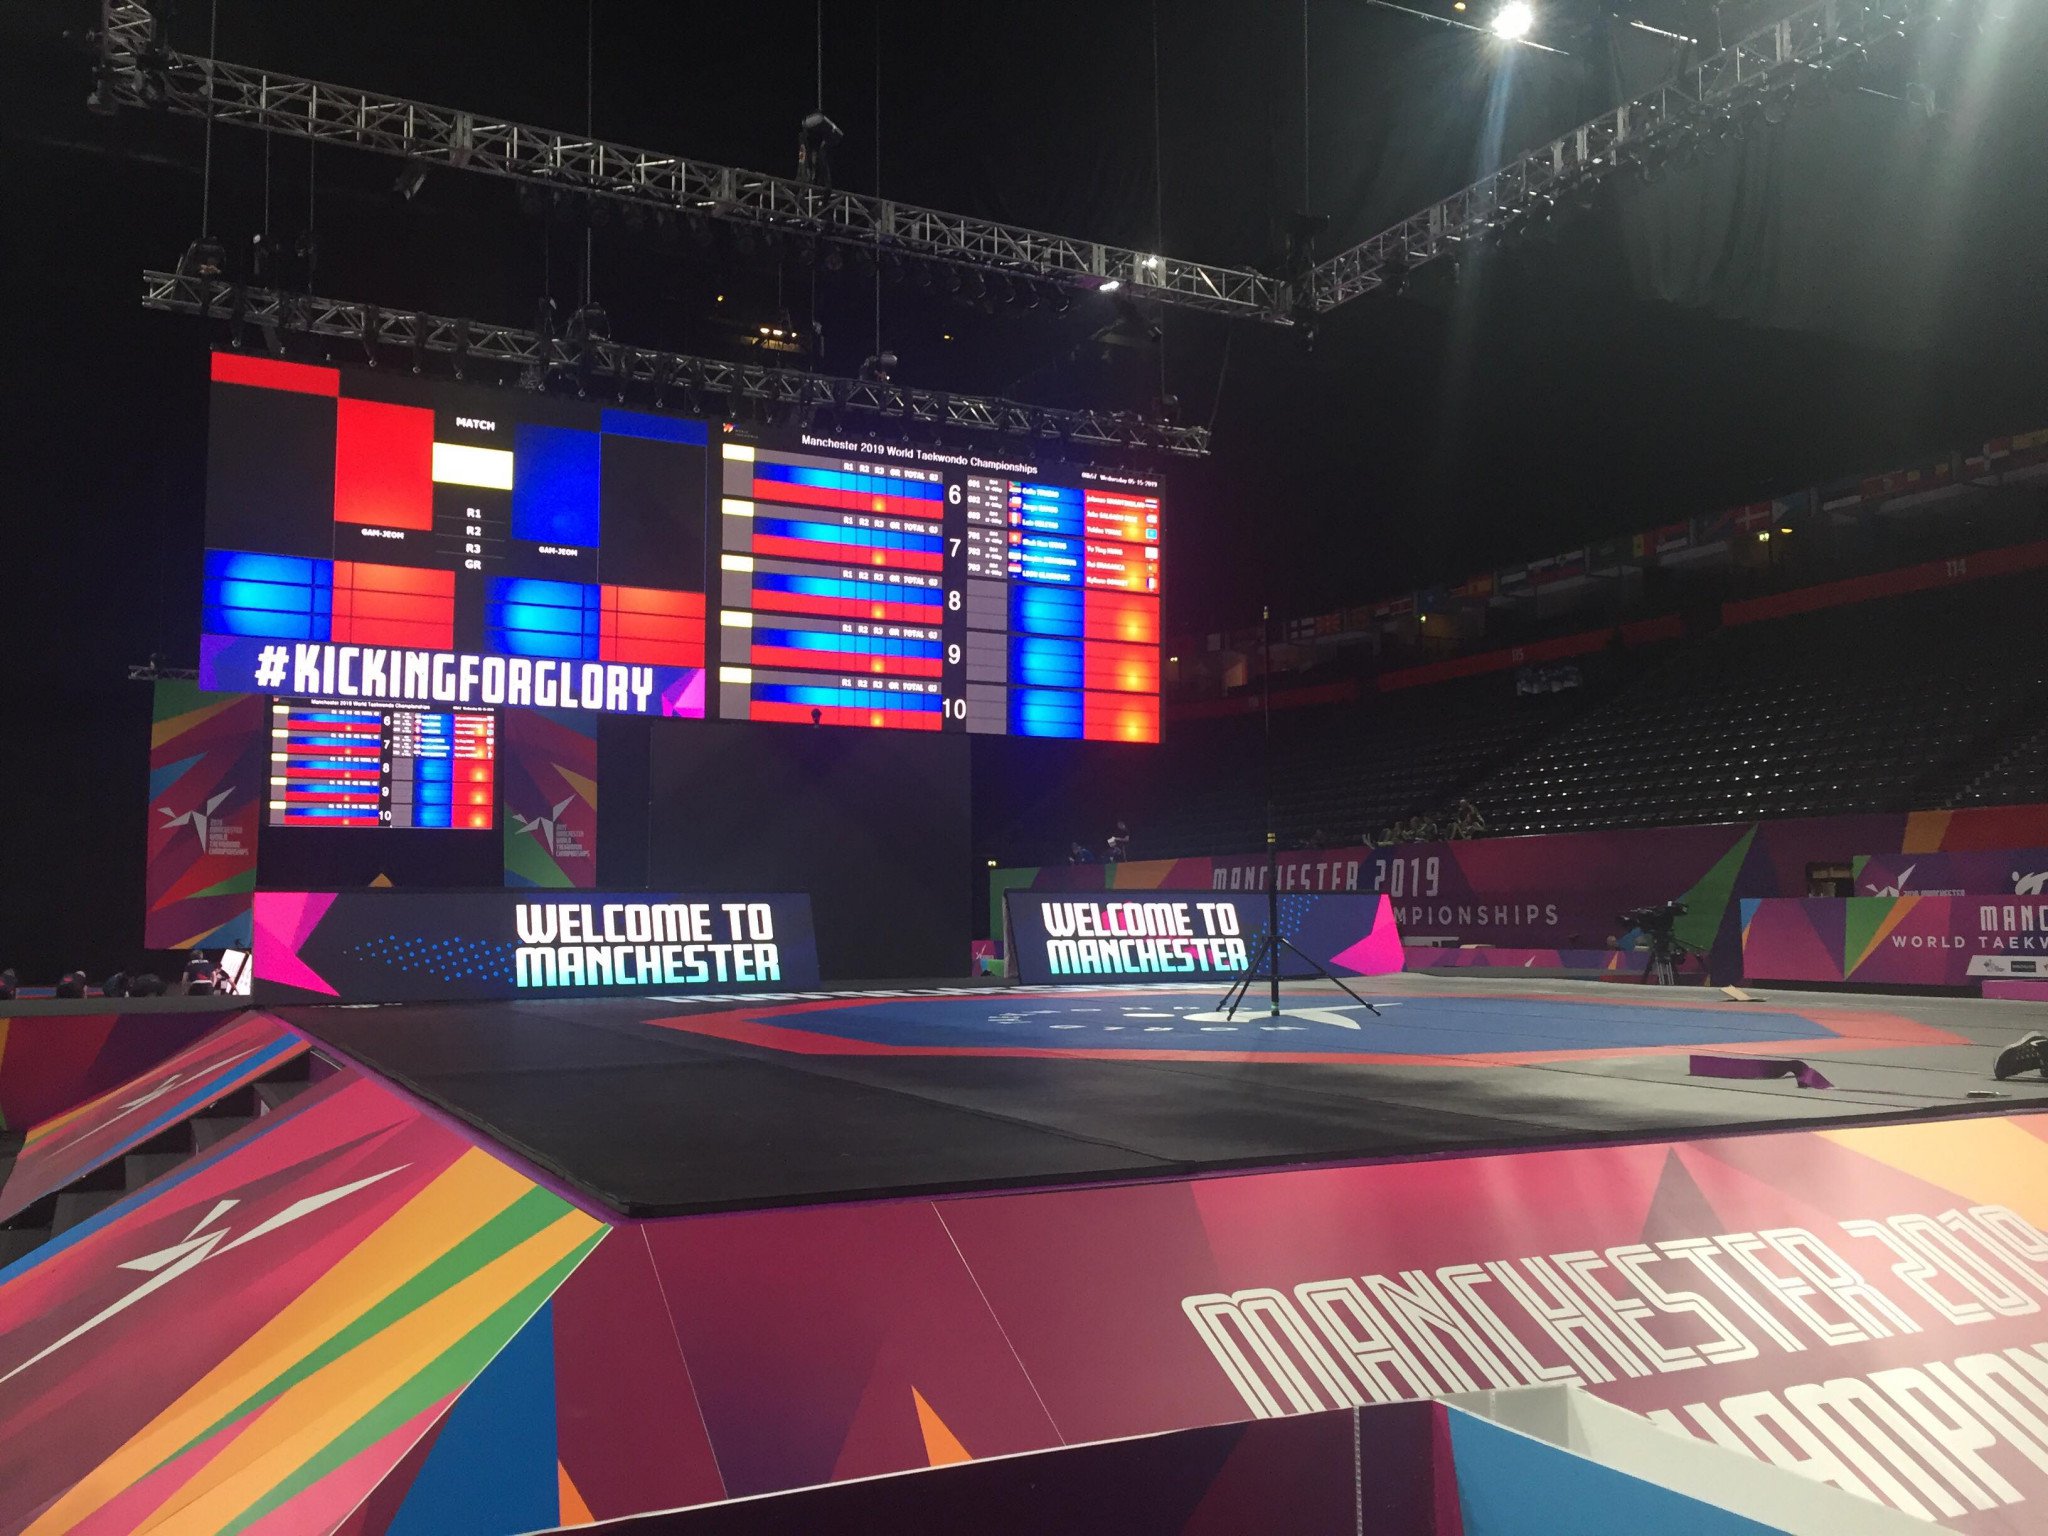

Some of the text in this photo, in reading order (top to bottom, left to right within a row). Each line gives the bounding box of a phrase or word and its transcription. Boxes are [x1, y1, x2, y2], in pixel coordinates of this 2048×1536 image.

[456, 417, 495, 431] MATCH
[802, 435, 1038, 474] Manchester 2019 World Taekwondo Championships
[844, 463, 853, 471] R1
[904, 470, 925, 480] TOTAL
[949, 485, 961, 504] 6
[467, 508, 481, 518] R1
[466, 526, 481, 536] R2
[844, 516, 853, 524] R1
[904, 523, 924, 532] TOTAL
[361, 528, 404, 539] GAM-JEOM
[466, 543, 480, 554] R3
[539, 546, 577, 556] GAM-JEOM
[949, 538, 960, 557] 7
[465, 559, 481, 570] GR
[843, 570, 852, 578] R1
[904, 576, 924, 585] TOTAL
[949, 591, 960, 610] 8
[842, 624, 852, 633] R1
[904, 629, 924, 638] TOTAL
[948, 644, 960, 664] 9
[255, 642, 654, 712] #KICKINGFORGLORY
[842, 678, 851, 687] R1
[903, 682, 923, 691] TOTAL
[943, 698, 966, 719] 10
[384, 716, 390, 726] 6
[384, 740, 390, 749] 7
[383, 763, 389, 773] 8
[382, 787, 389, 796] 9
[379, 811, 391, 820] 10
[516, 903, 774, 943] WELCOME TO
[1041, 903, 1240, 936] WELCOME TO
[1892, 935, 1965, 948] WORLD
[1046, 938, 1249, 974] MANCHESTER
[516, 944, 780, 987] MANCHESTER
[1181, 1227, 1924, 1420] MANCHESTER
